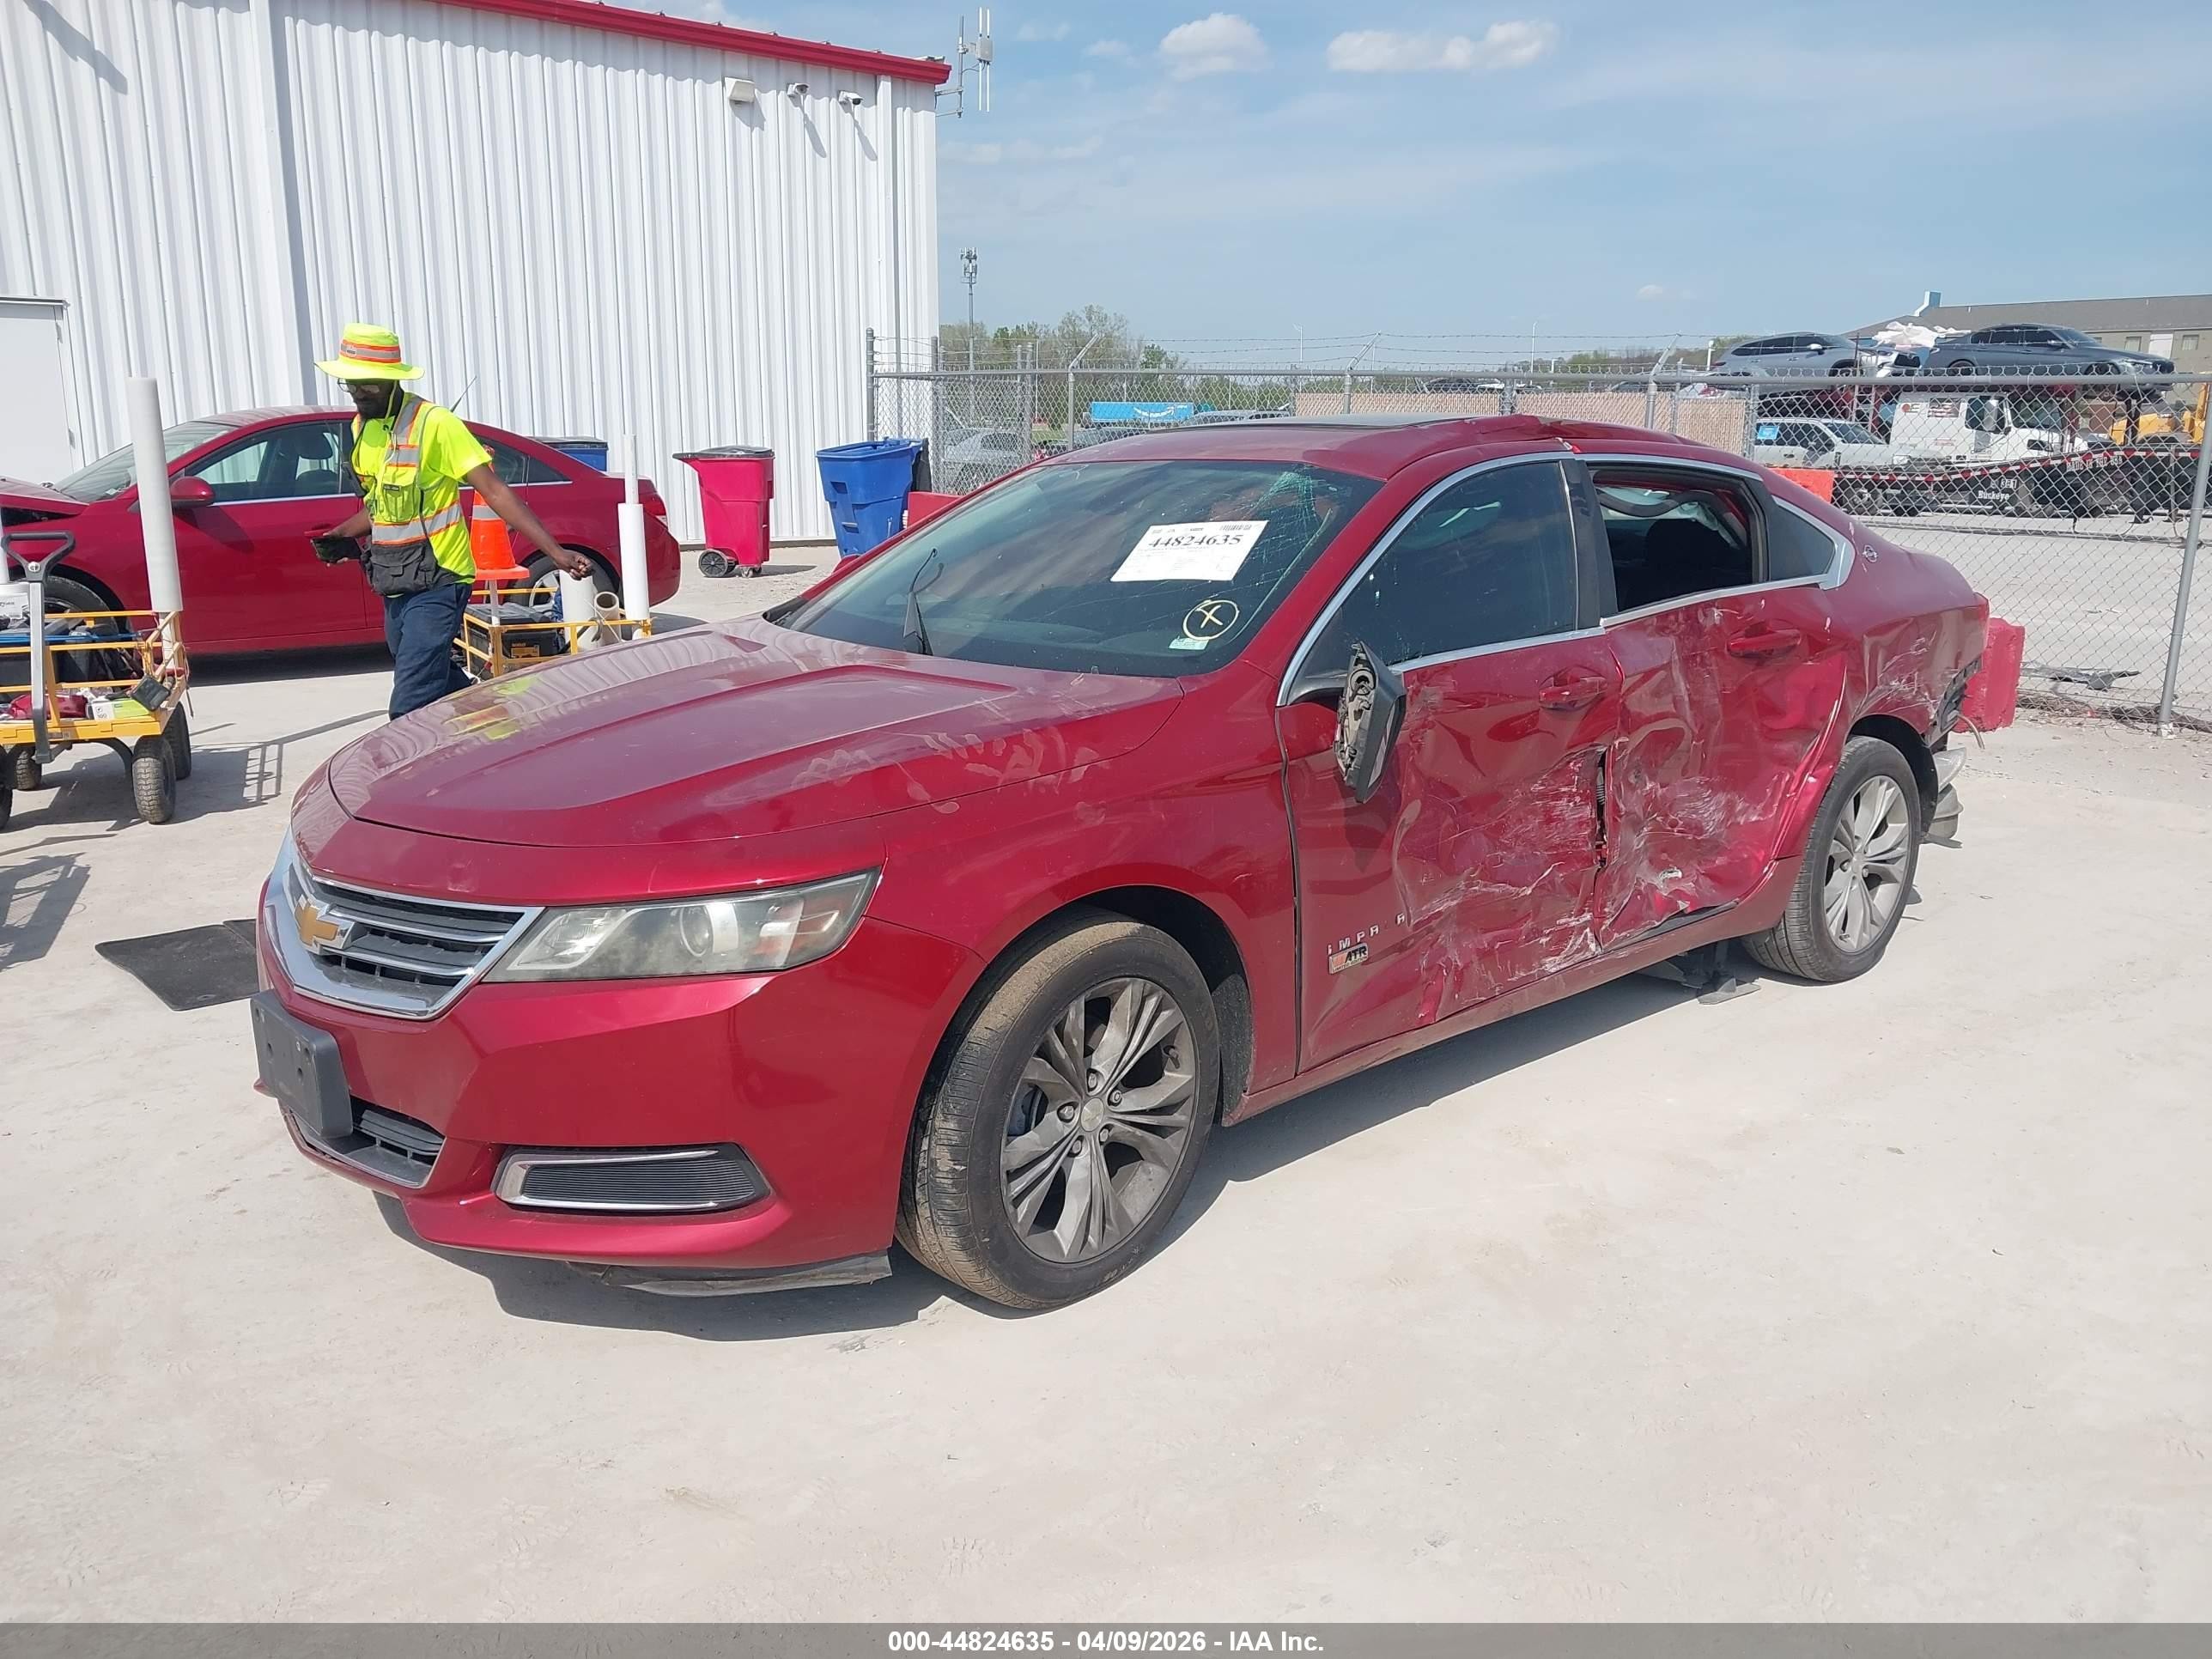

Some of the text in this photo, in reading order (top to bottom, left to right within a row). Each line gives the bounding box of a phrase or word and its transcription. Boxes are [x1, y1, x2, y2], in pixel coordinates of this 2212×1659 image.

[1978, 490, 2010, 501] Buckeye
[1149, 534, 1243, 548] 44824635
[1345, 945, 1367, 963] ATR
